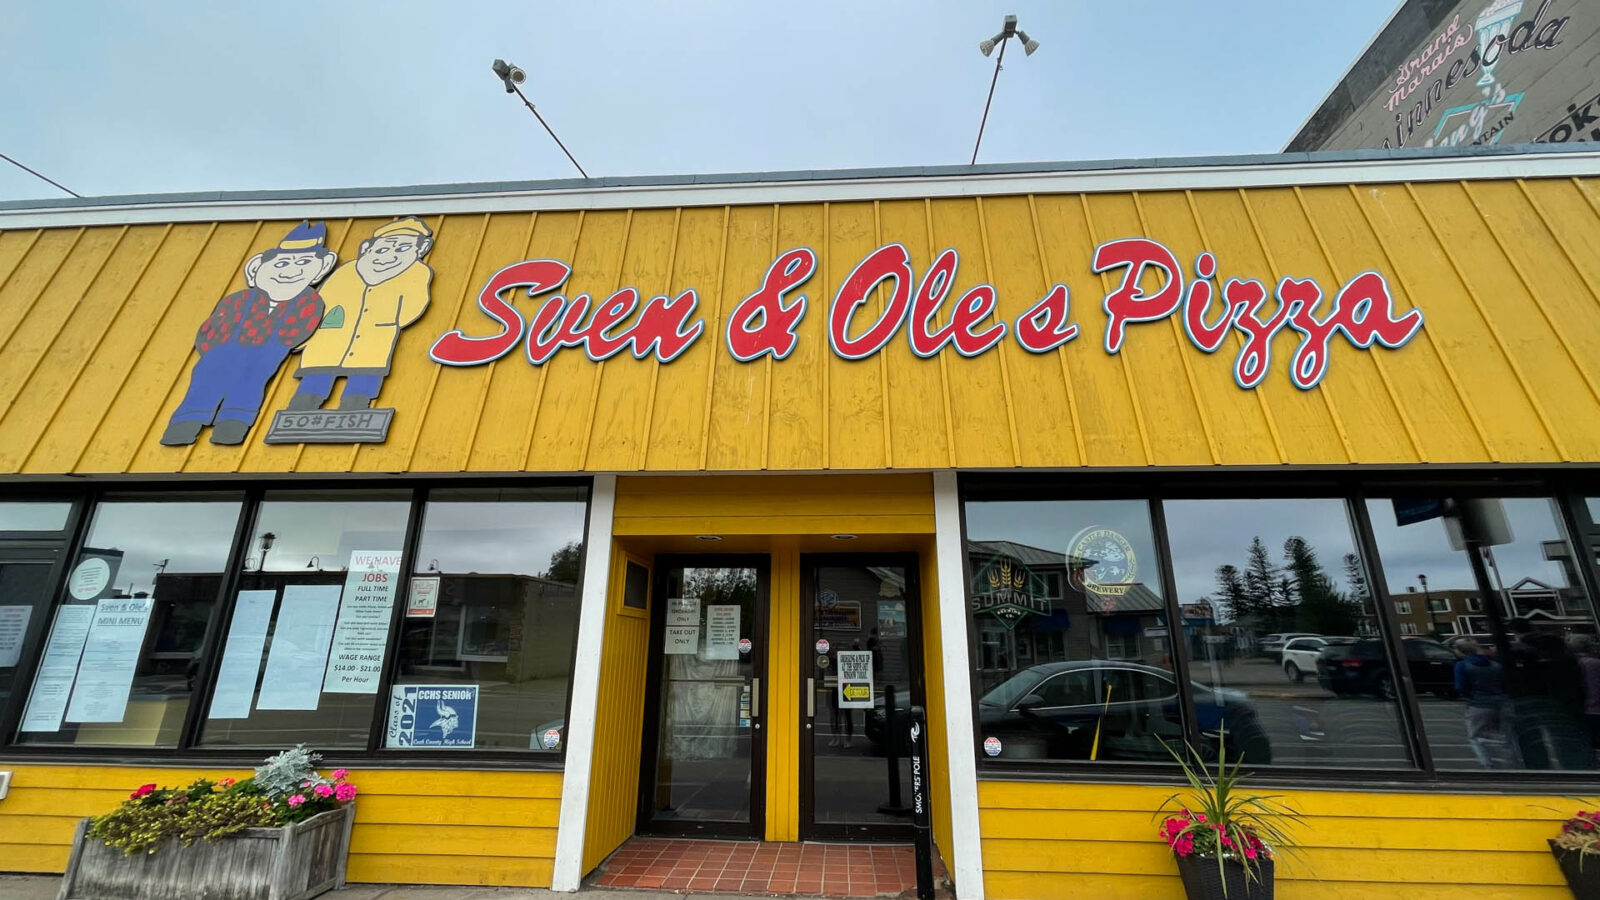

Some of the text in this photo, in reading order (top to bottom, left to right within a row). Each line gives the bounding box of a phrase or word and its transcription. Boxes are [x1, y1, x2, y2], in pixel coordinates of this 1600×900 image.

[429, 258, 705, 366] Sven
[726, 245, 817, 363] &
[1091, 236, 1424, 391] Pizza
[355, 555, 402, 566] WE HAVE
[362, 573, 388, 583] JOBS
[1087, 583, 1123, 594] BREWERY
[971, 589, 1047, 612] SUMMIT
[98, 617, 144, 625] MINI MENU
[359, 654, 381, 662] RANGE
[334, 664, 355, 672] $14.00
[418, 690, 472, 700] CCHS SENIOR
[389, 694, 403, 738] Class of
[399, 687, 418, 746] 2021
